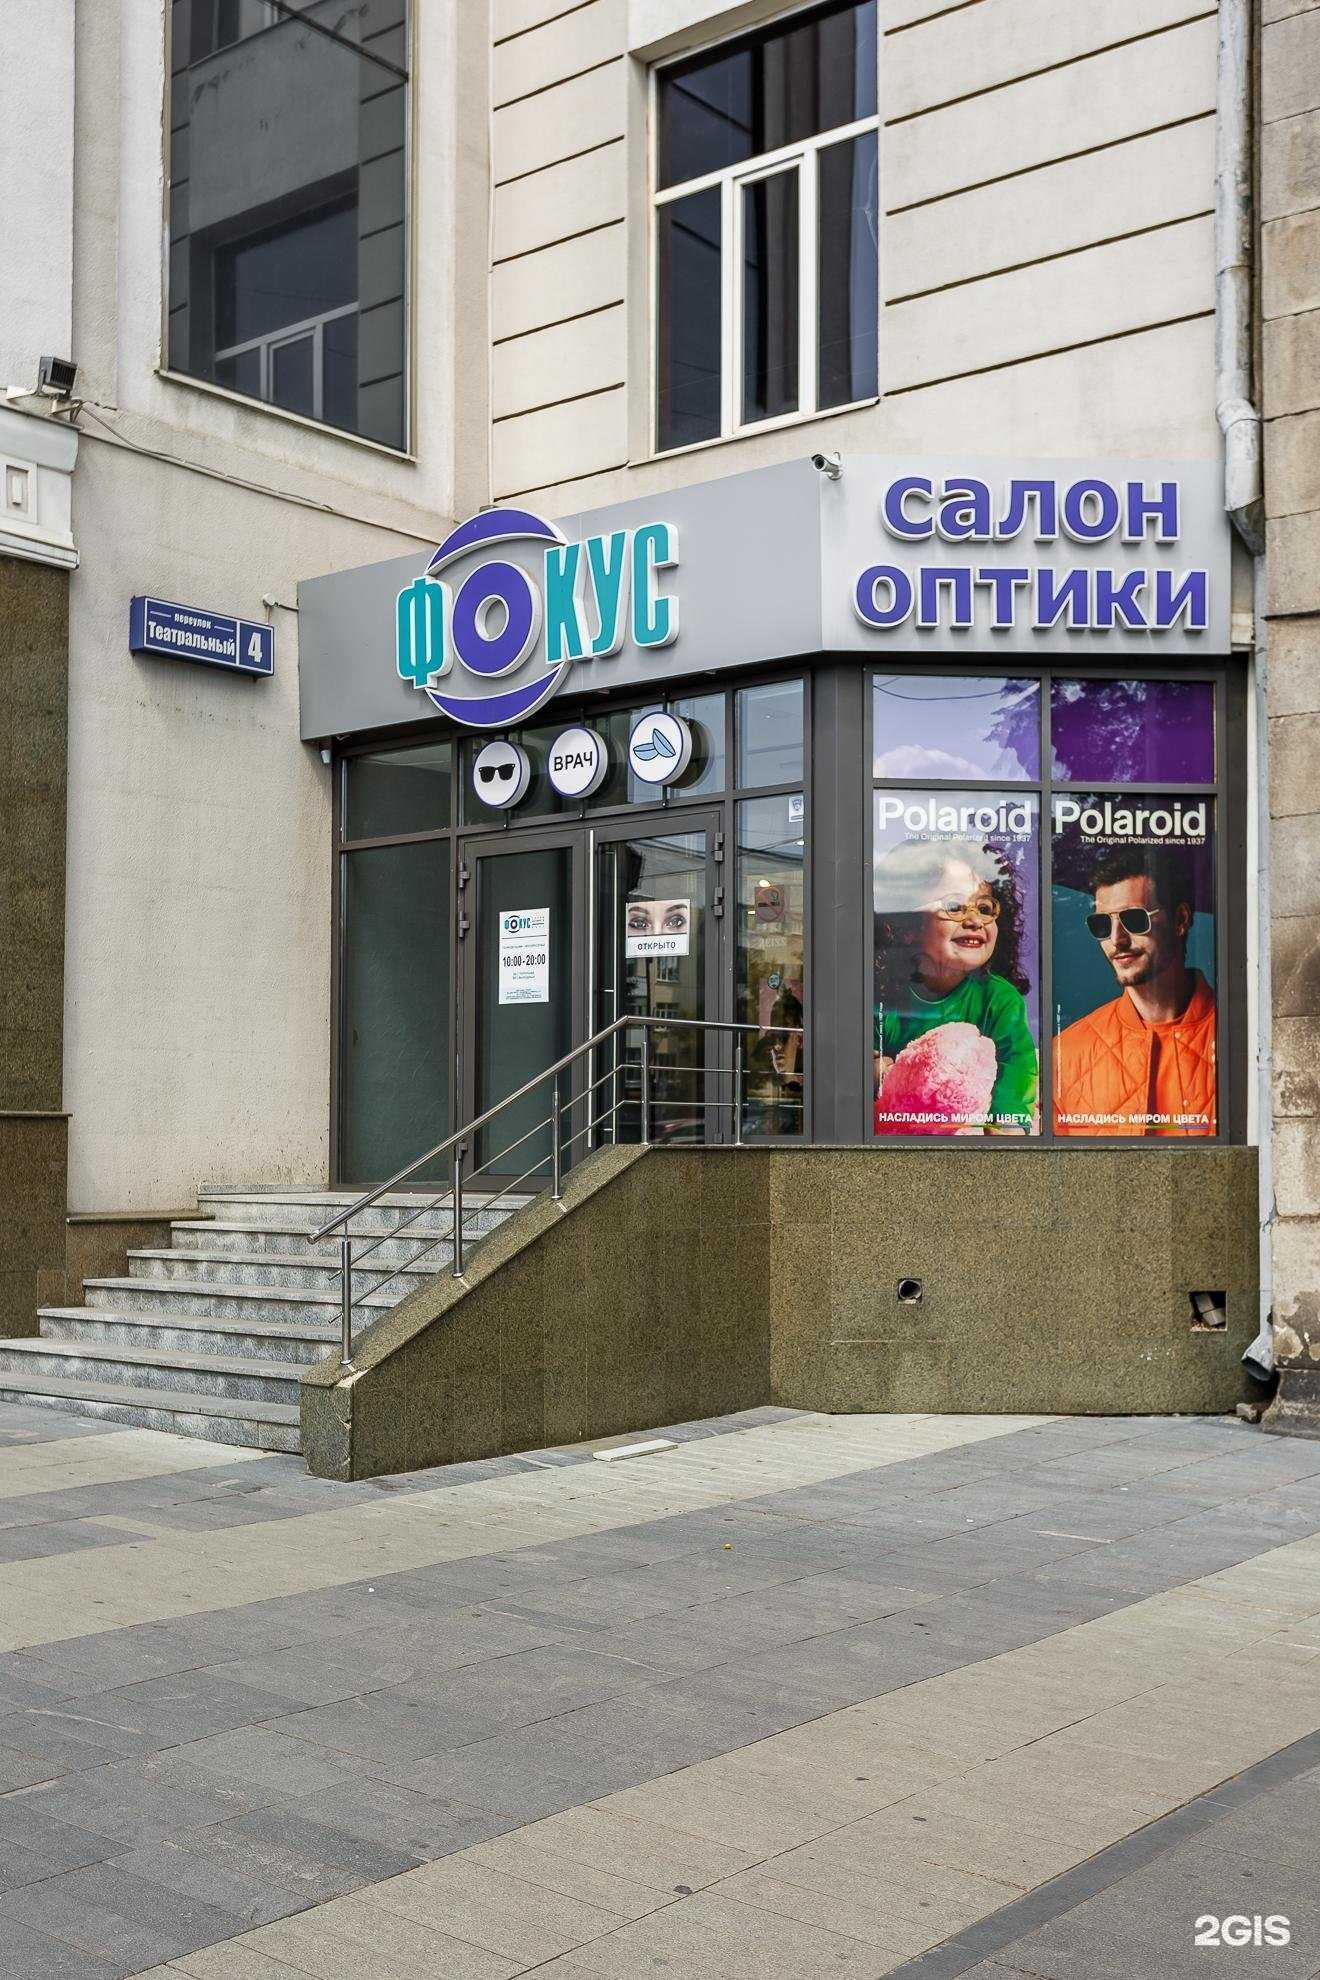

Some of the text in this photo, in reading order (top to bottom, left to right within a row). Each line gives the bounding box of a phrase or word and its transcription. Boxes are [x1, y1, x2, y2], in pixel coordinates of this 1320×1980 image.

[396, 521, 679, 689] ФОКУС
[174, 613, 212, 629] переулок
[148, 621, 235, 656] Театральный
[247, 632, 263, 663] 4
[553, 750, 593, 772] ВРАЧ
[878, 797, 1032, 833] Polaroid
[1055, 799, 1206, 836] Polaroid
[904, 831, 920, 840] The
[990, 833, 1011, 842] since
[1080, 835, 1206, 846] The Original Polarized since 1937
[637, 941, 676, 951] ОТКРЫТО
[879, 1112, 1033, 1124] НАСЛАДИСЬ МИРОМ ЦВЕТА
[1057, 1113, 1209, 1125] НАСЛАДИСЬ МИРОМ ЦВЕТА
